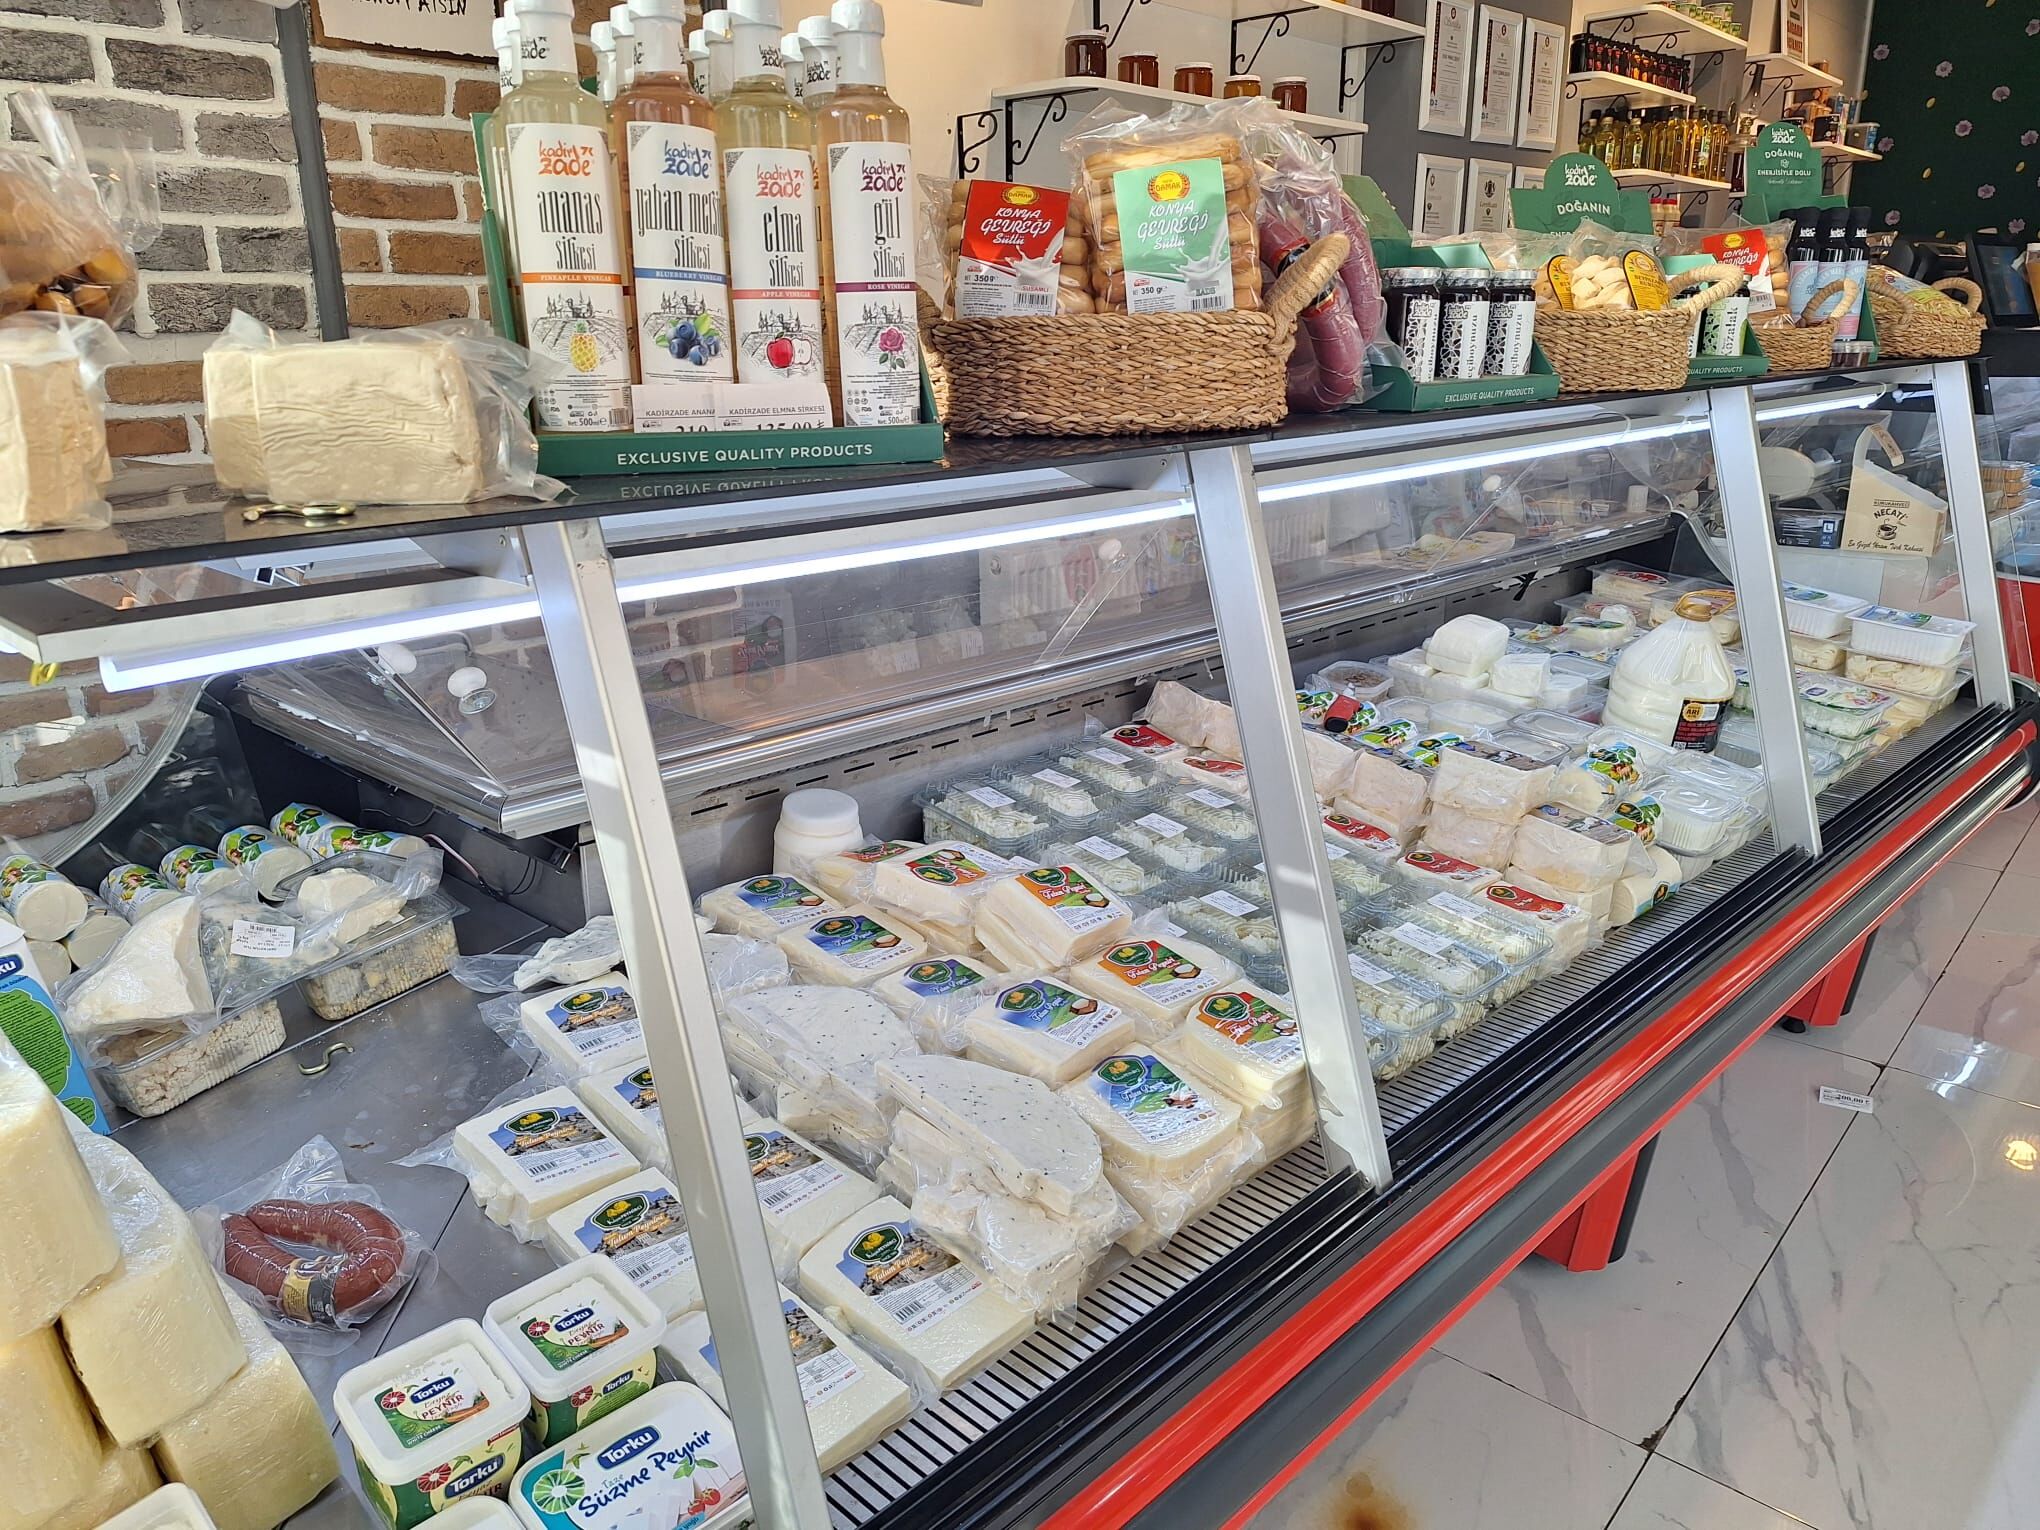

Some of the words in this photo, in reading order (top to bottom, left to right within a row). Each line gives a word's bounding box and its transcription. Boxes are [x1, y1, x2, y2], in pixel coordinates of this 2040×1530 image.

[537, 190, 604, 235] ananas
[635, 183, 685, 237] yaban
[995, 206, 1043, 221] KONYA
[1149, 199, 1196, 220] KONYA
[1556, 199, 1612, 216] DOĞANIN
[763, 205, 804, 253] elma
[873, 196, 901, 245] gül
[555, 235, 598, 271] sirkesi
[673, 235, 711, 270] sirkesi
[1141, 286, 1155, 296] 350
[1444, 393, 1478, 404] EXCLUSIVE
[1478, 390, 1504, 401] QUALITY
[1503, 386, 1536, 398] PRODUCTS
[645, 408, 690, 417] KADİRZADE
[729, 406, 771, 416] KADİRZADE
[616, 450, 710, 466] EXCLUSIVE
[714, 447, 786, 462] QUALITY
[790, 443, 874, 459] PRODUCTS
[558, 1310, 591, 1330] Torku
[413, 1378, 451, 1400] Torku
[606, 1373, 631, 1392] Torku
[600, 1430, 655, 1464] Torku
[449, 1459, 499, 1493] Torku
[578, 1466, 653, 1518] Süzme
[646, 1429, 712, 1472] Peynir
